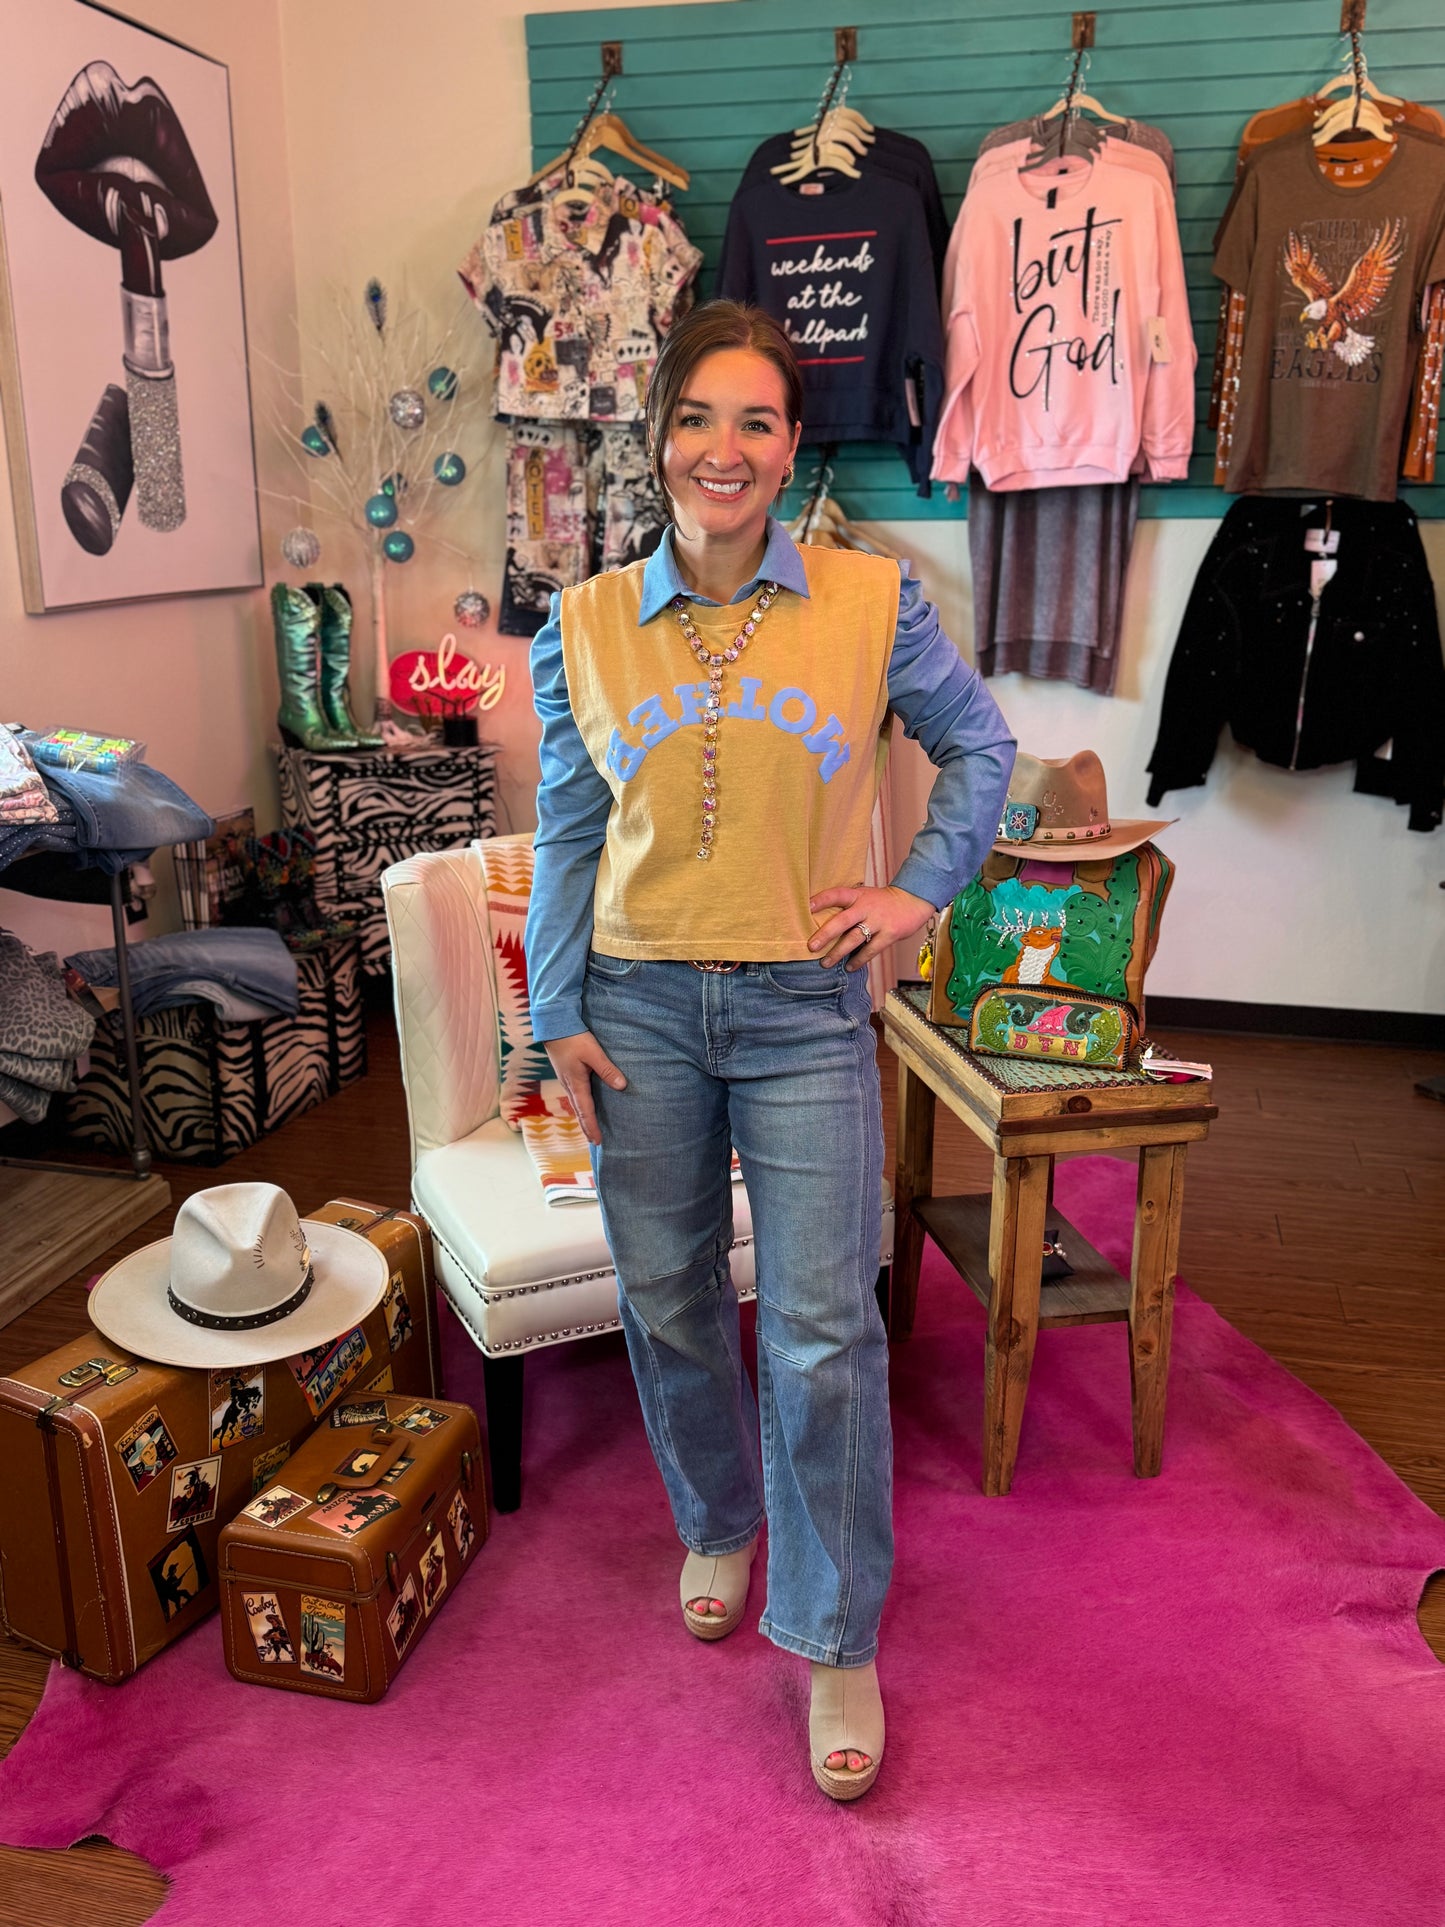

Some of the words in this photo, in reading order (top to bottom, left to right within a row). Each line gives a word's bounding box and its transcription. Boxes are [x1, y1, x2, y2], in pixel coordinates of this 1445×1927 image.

[770, 241, 875, 276] weekends
[1013, 207, 1122, 318] but
[787, 284, 816, 309] at
[818, 281, 862, 308] the
[1009, 288, 1121, 412] God
[1270, 348, 1383, 383] EAGLES
[408, 633, 506, 711] slay
[605, 677, 850, 784] MOTHER
[305, 1330, 366, 1410] TEXAS
[322, 1490, 357, 1514] ARIZONA
[246, 1596, 277, 1616] Cowboy
